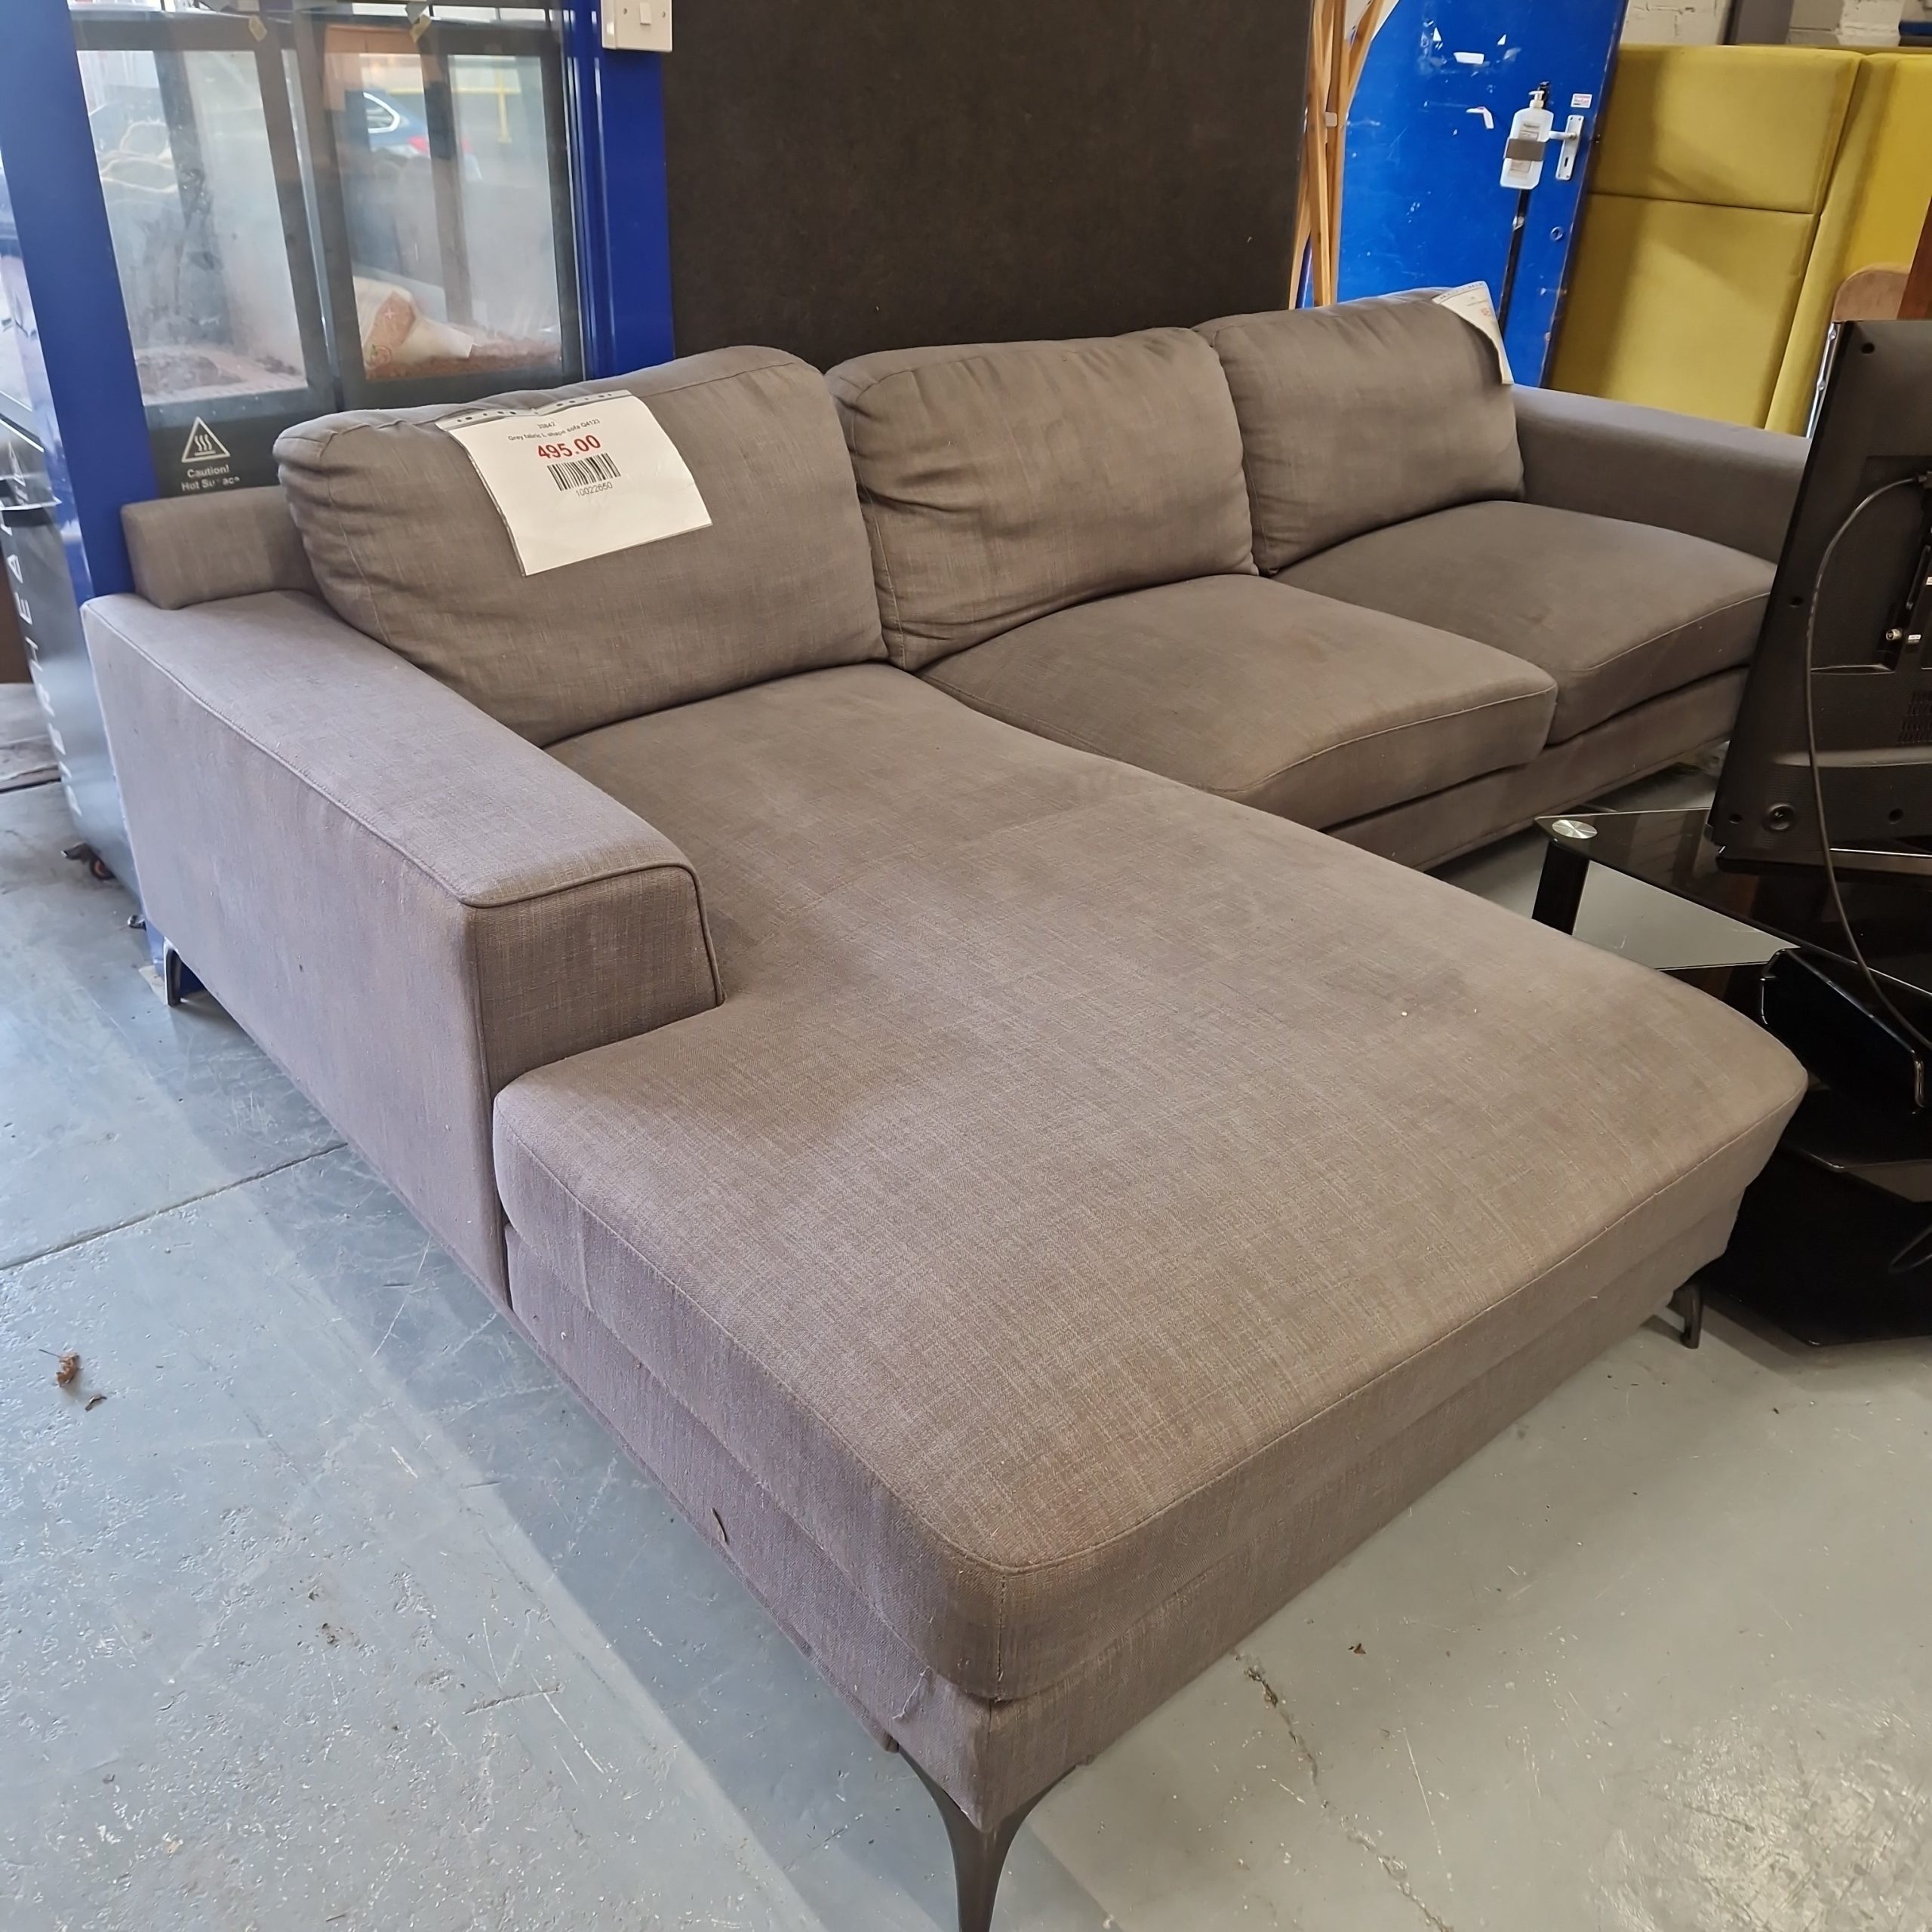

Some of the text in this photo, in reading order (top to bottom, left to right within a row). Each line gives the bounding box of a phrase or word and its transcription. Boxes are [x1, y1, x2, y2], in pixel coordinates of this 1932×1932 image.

[537, 435, 601, 459] 495.00
[186, 463, 230, 478] Caution!
[181, 482, 201, 491] Hot
[576, 481, 613, 497] 10022650
